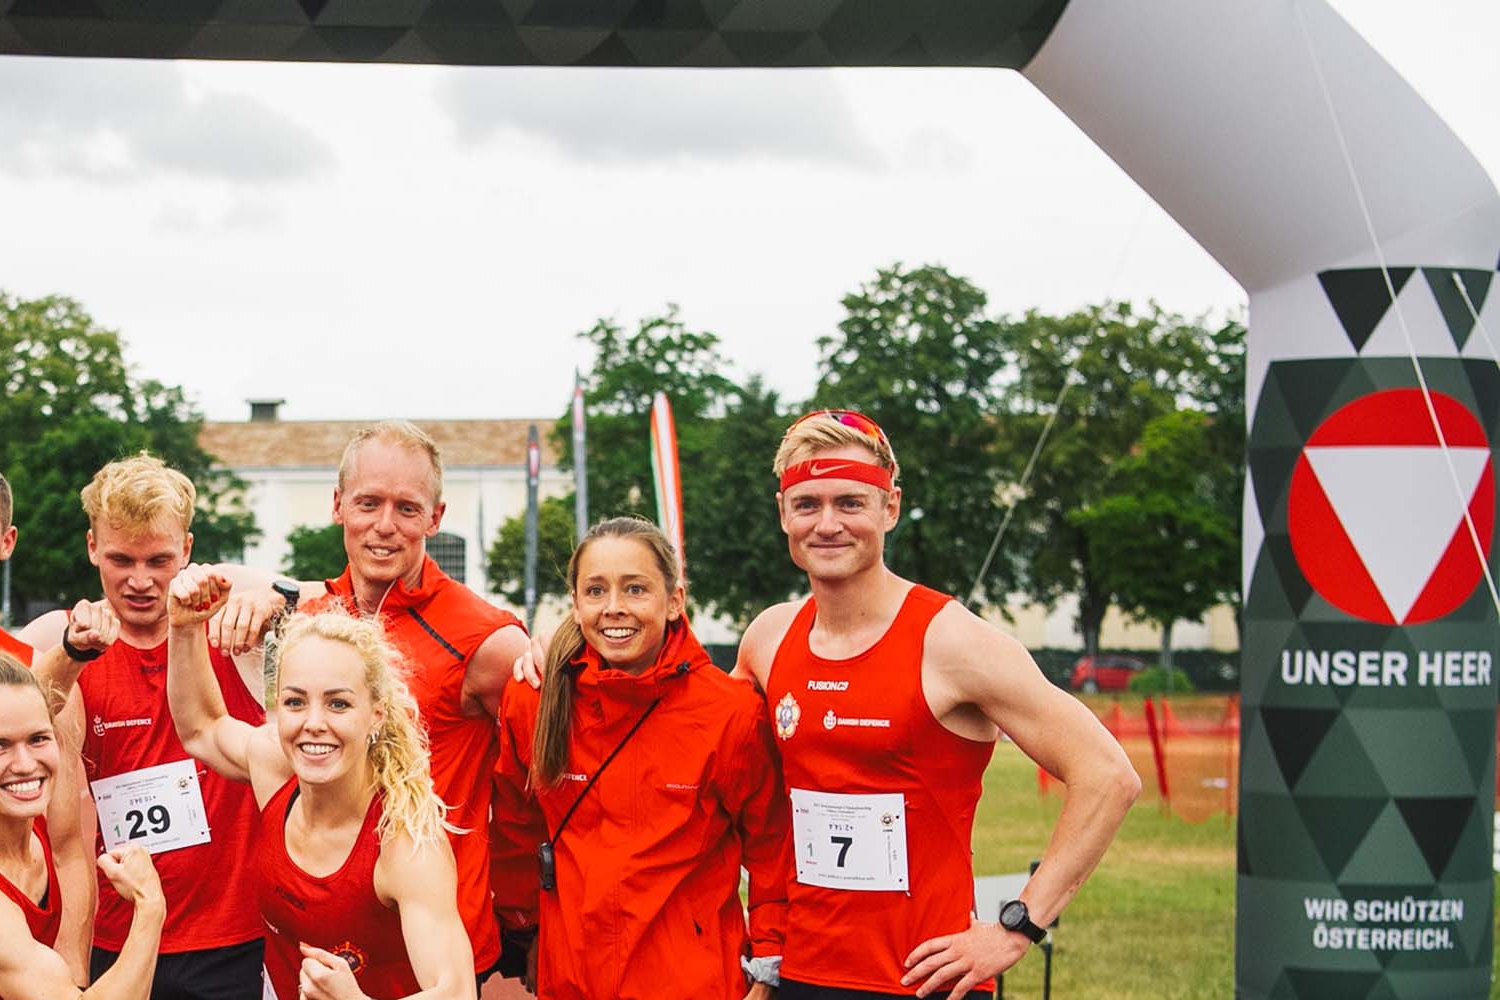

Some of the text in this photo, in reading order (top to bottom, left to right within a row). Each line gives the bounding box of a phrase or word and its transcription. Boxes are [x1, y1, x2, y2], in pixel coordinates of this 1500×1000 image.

[1281, 650, 1492, 687] UNSER HEER
[114, 824, 121, 838] 1
[125, 804, 171, 840] 29
[830, 835, 853, 868] 7
[1304, 896, 1464, 922] WIR SCHÜTZEN
[1313, 923, 1454, 950] ÖSTERREICH.
